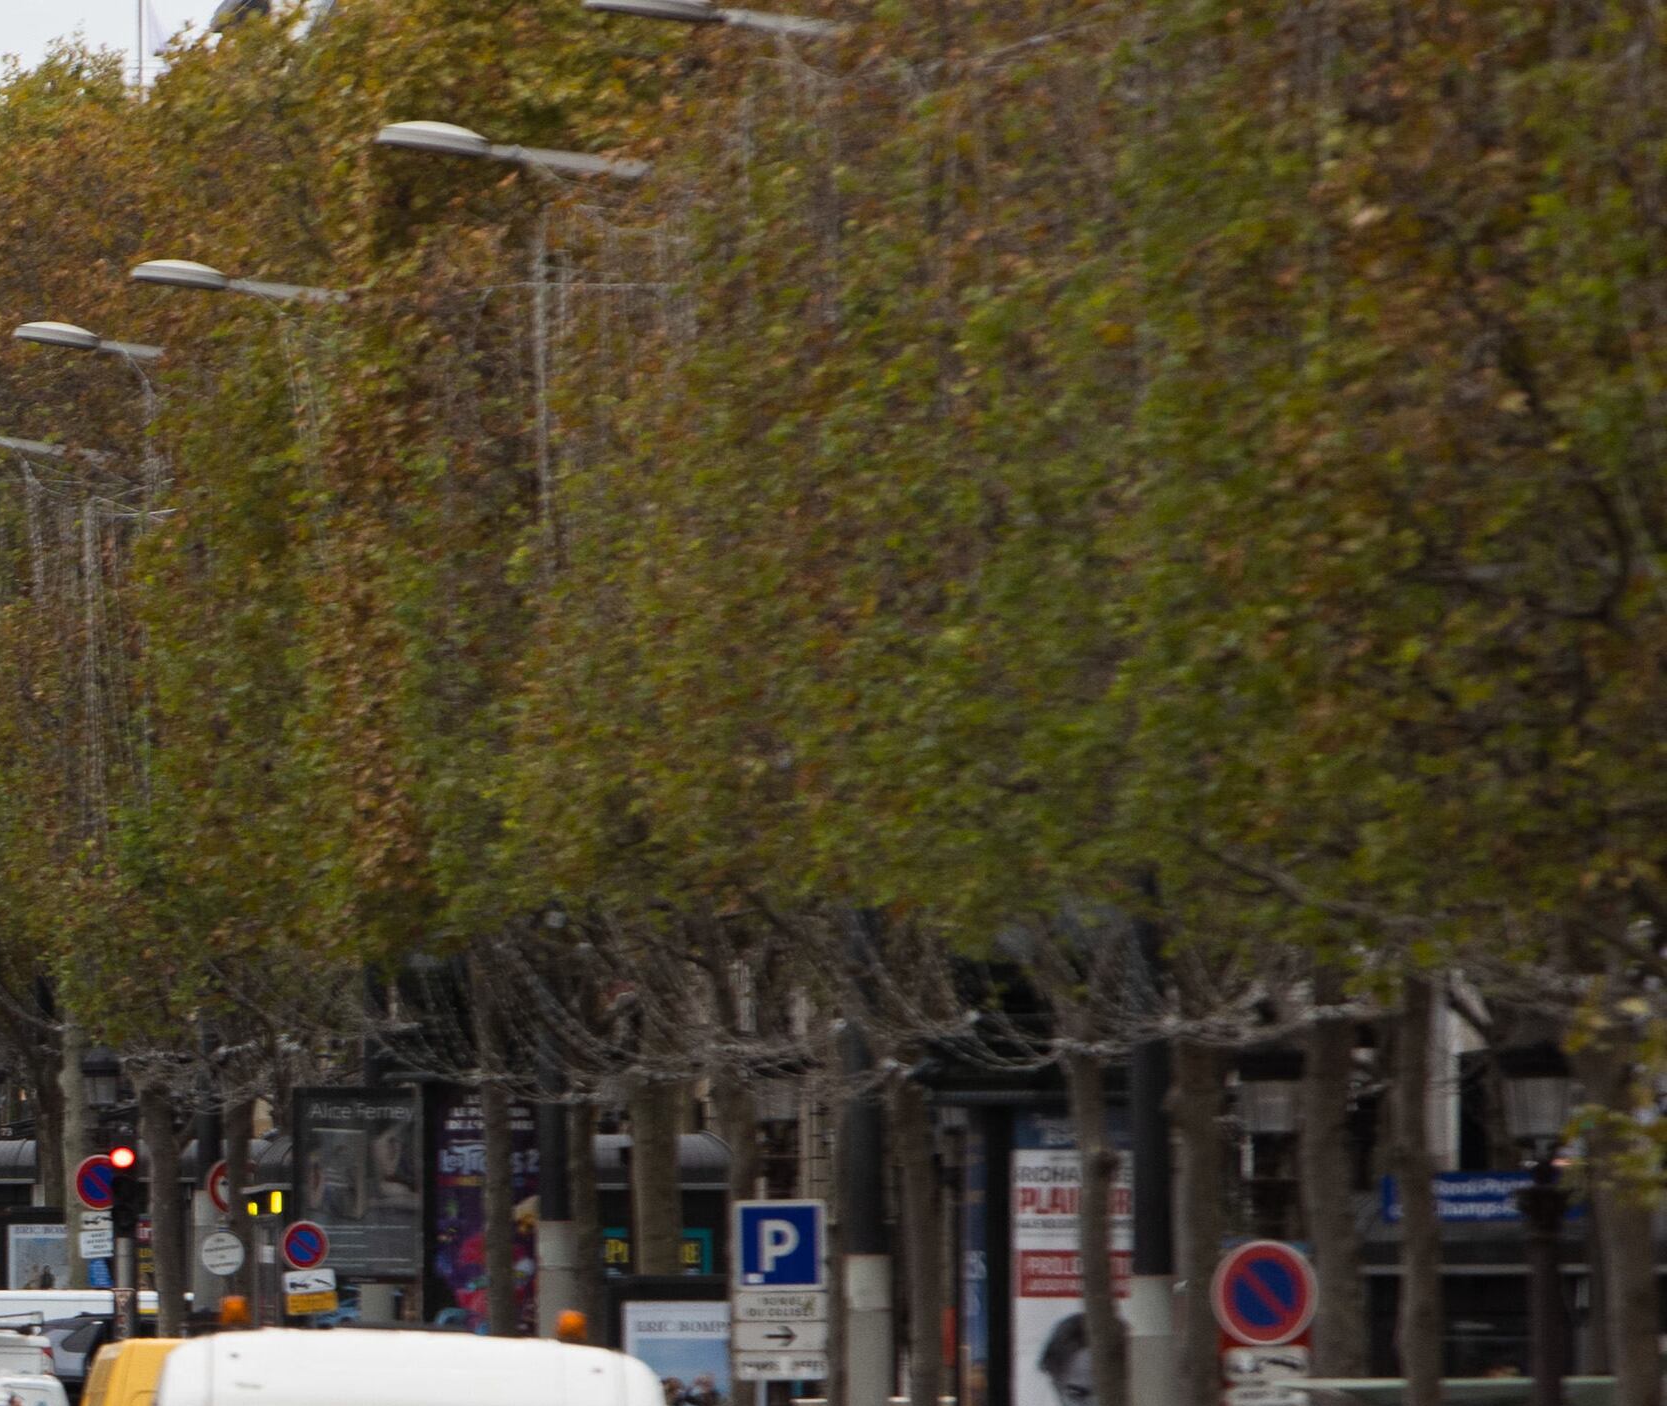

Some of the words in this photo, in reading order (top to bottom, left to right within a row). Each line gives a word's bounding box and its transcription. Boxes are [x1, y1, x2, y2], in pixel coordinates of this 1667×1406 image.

[309, 1102, 351, 1119] Alice
[357, 1102, 415, 1121] Ferney
[759, 1219, 800, 1272] P
